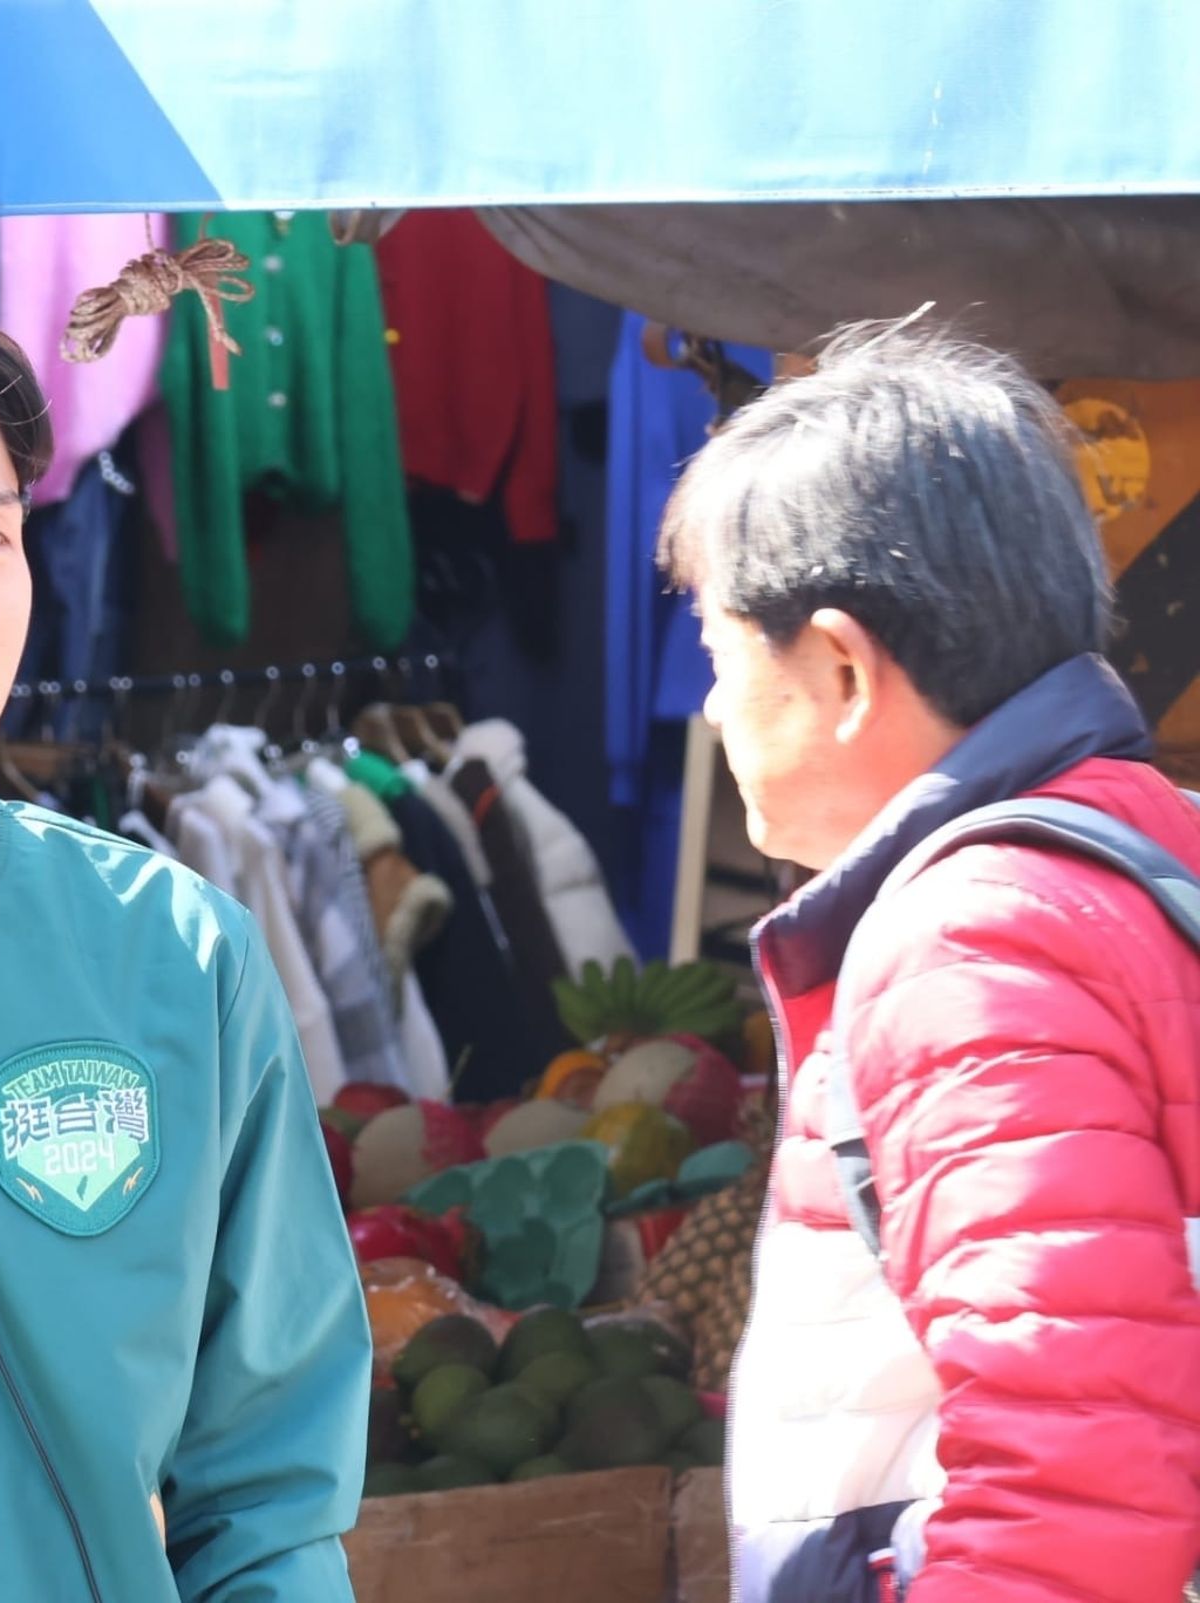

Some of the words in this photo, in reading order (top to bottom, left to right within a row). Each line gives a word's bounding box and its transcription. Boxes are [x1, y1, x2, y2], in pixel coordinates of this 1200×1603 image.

[2, 1061, 64, 1101] TEAM
[61, 1060, 140, 1091] TAIWAN
[0, 1087, 149, 1160] 挺台灣
[43, 1140, 115, 1176] 2024
